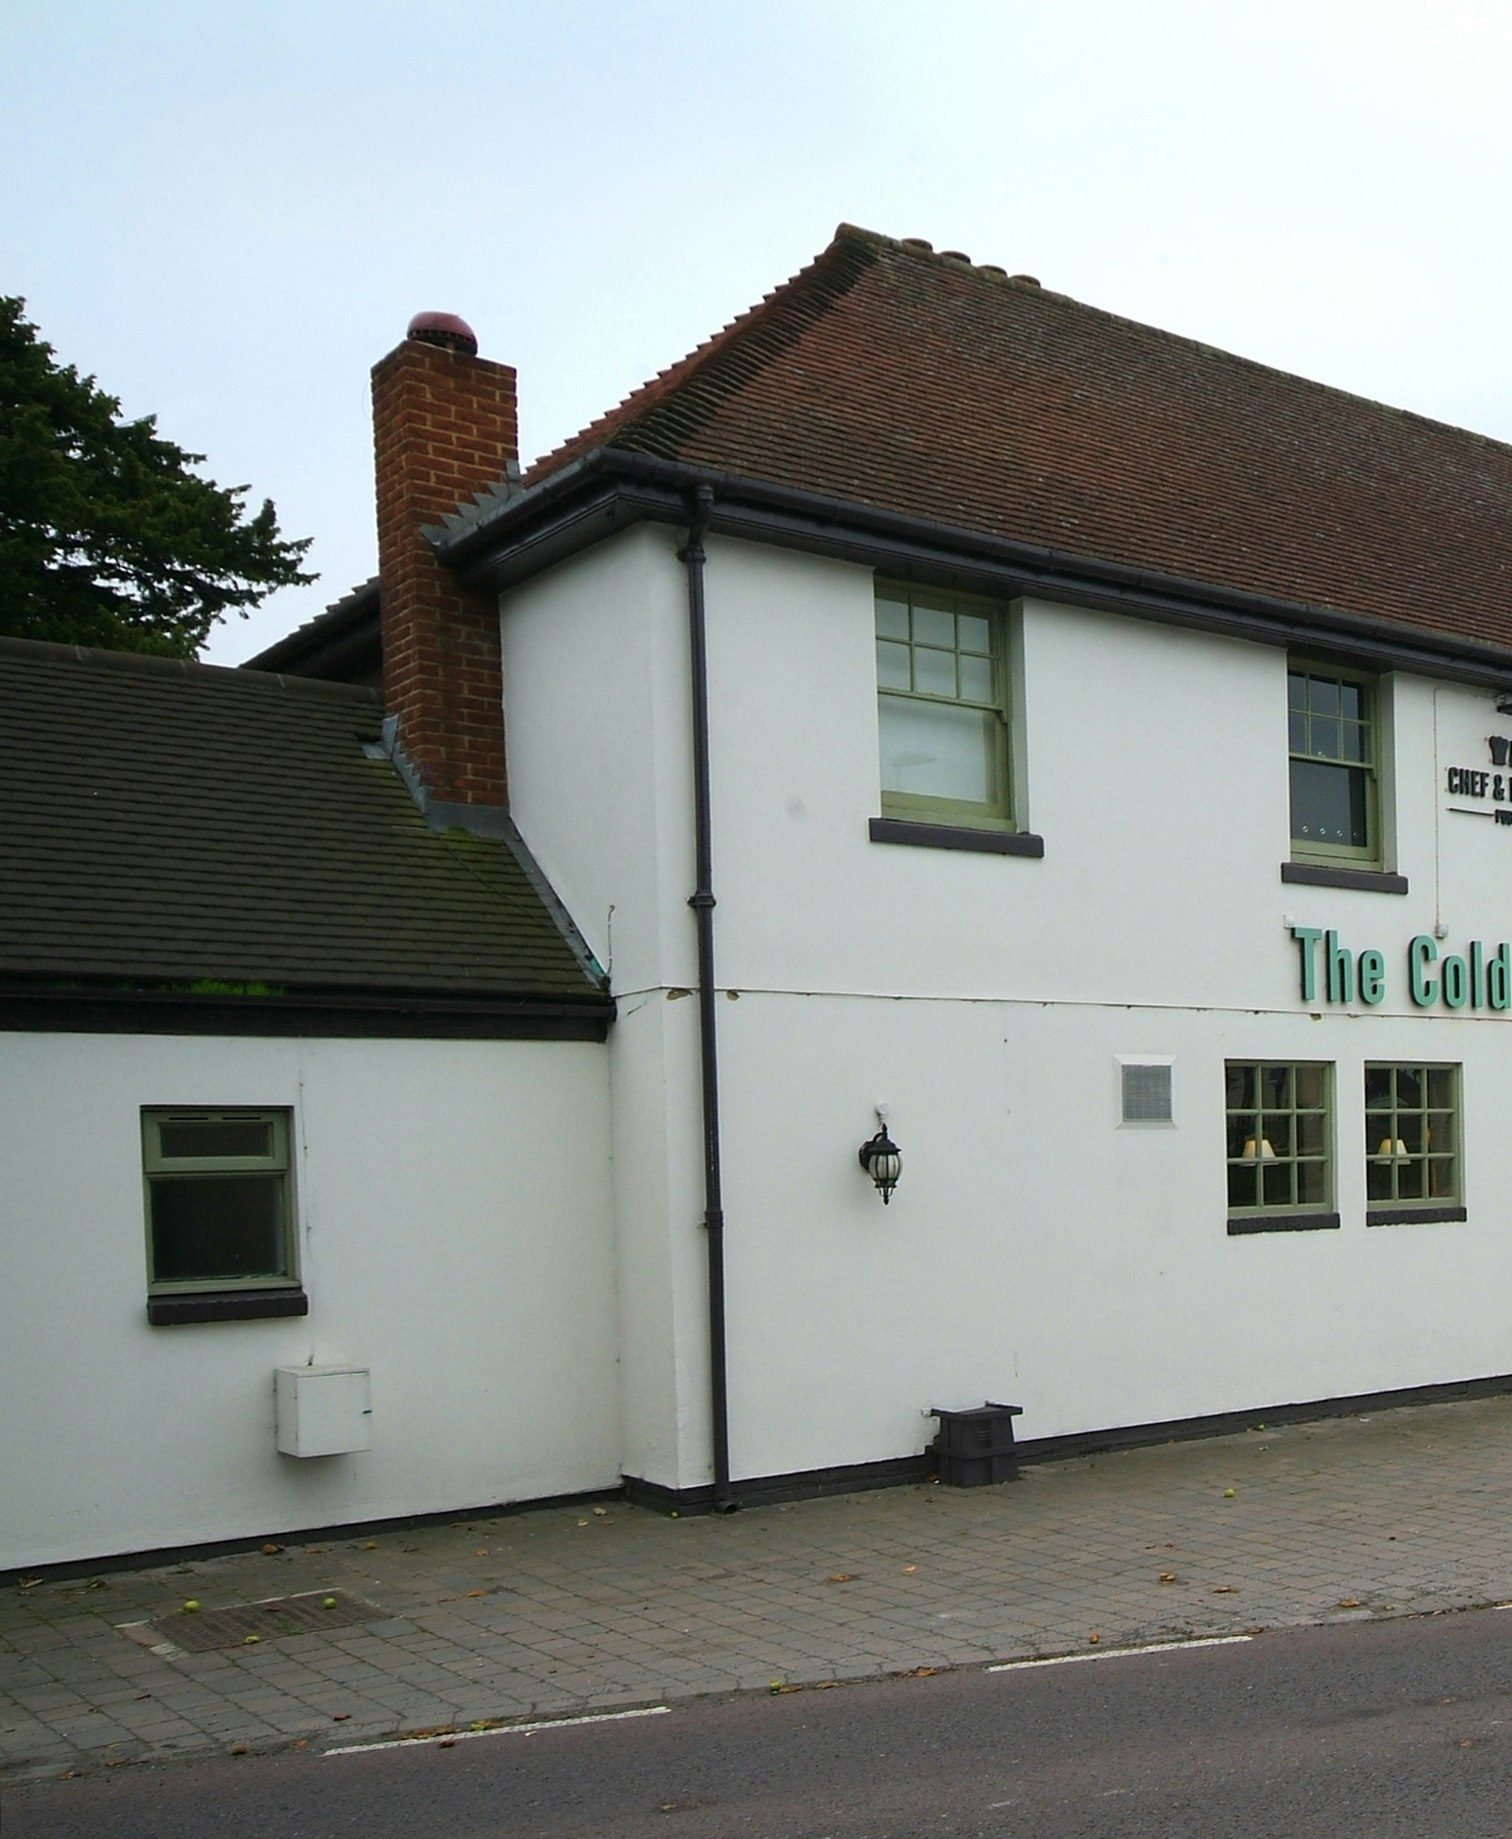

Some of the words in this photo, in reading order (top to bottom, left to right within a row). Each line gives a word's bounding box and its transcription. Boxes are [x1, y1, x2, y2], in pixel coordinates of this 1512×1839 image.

[1448, 766, 1490, 798] CHEF
[1493, 774, 1505, 801] &
[1494, 809, 1512, 827] PUB
[1291, 926, 1386, 1005] The
[1409, 934, 1512, 1010] Cold
